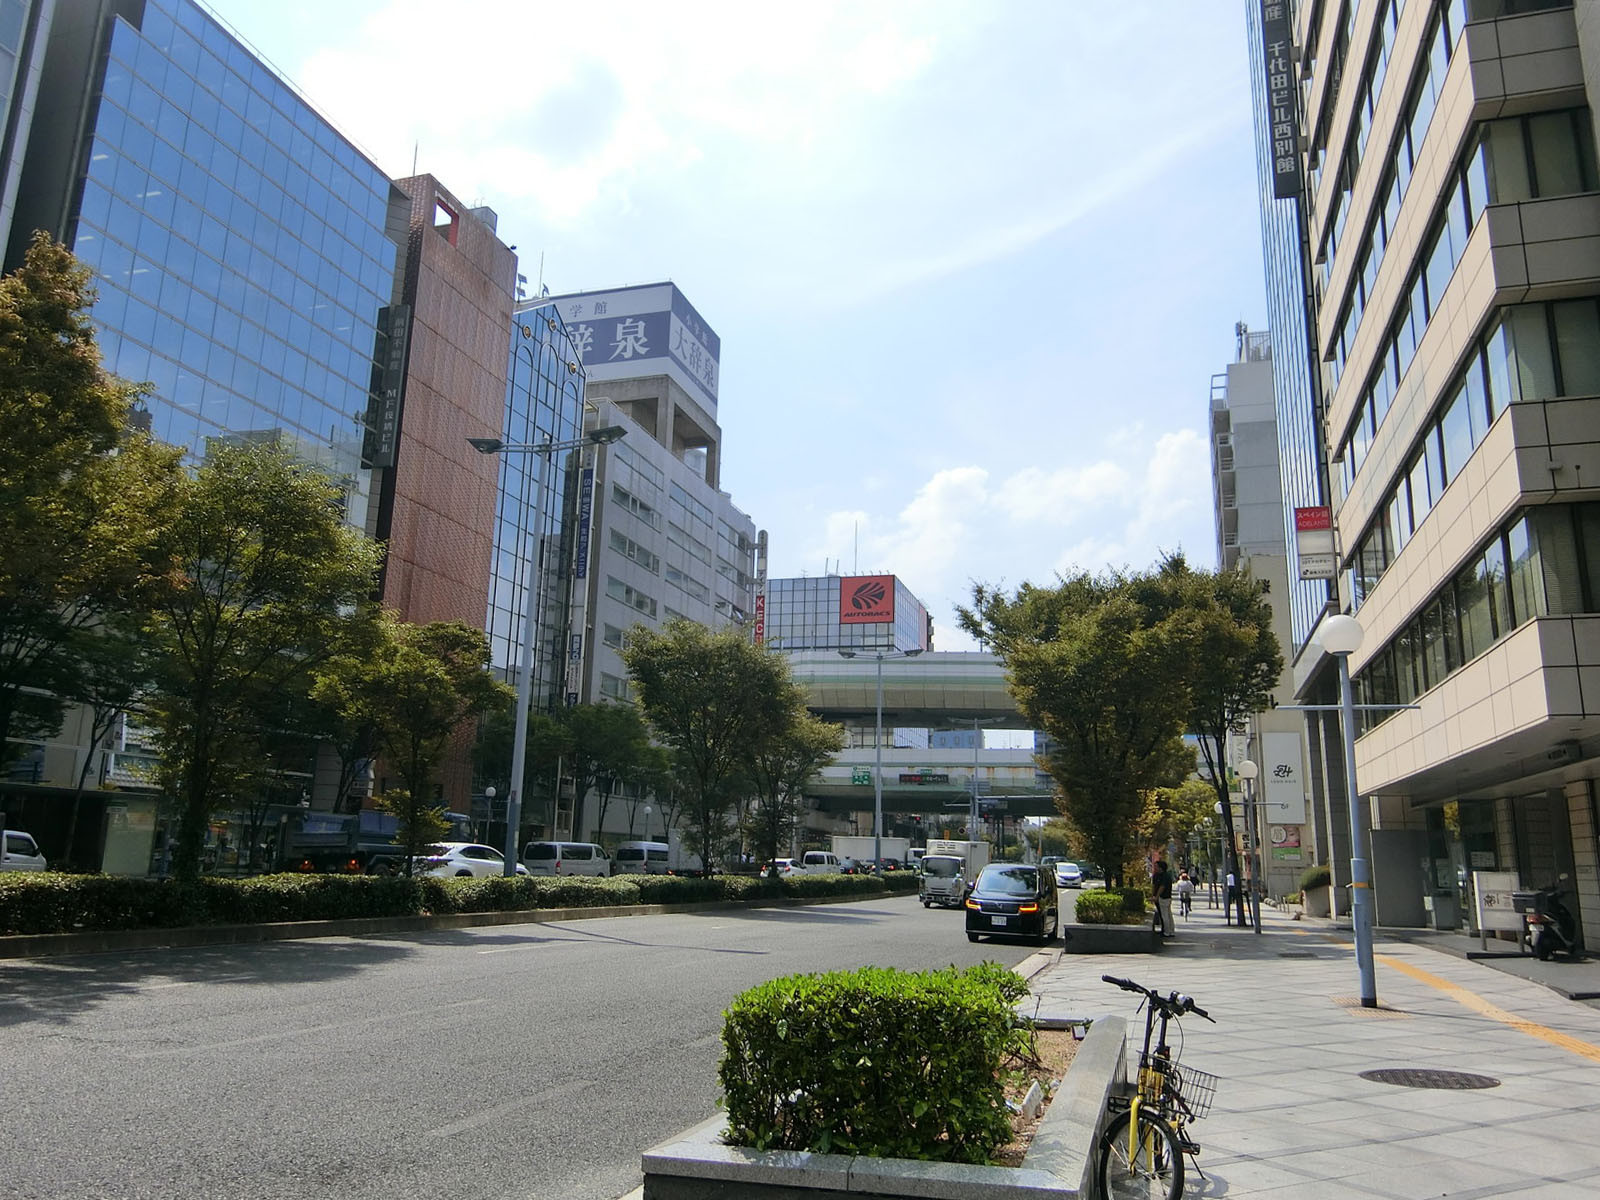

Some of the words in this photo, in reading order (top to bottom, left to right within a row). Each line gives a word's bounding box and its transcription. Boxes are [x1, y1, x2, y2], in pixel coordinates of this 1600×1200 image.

[1268, 40, 1296, 173] 千代田ビル西別館
[672, 325, 714, 389] 大辞泉
[843, 610, 891, 618] AUTOBACS
